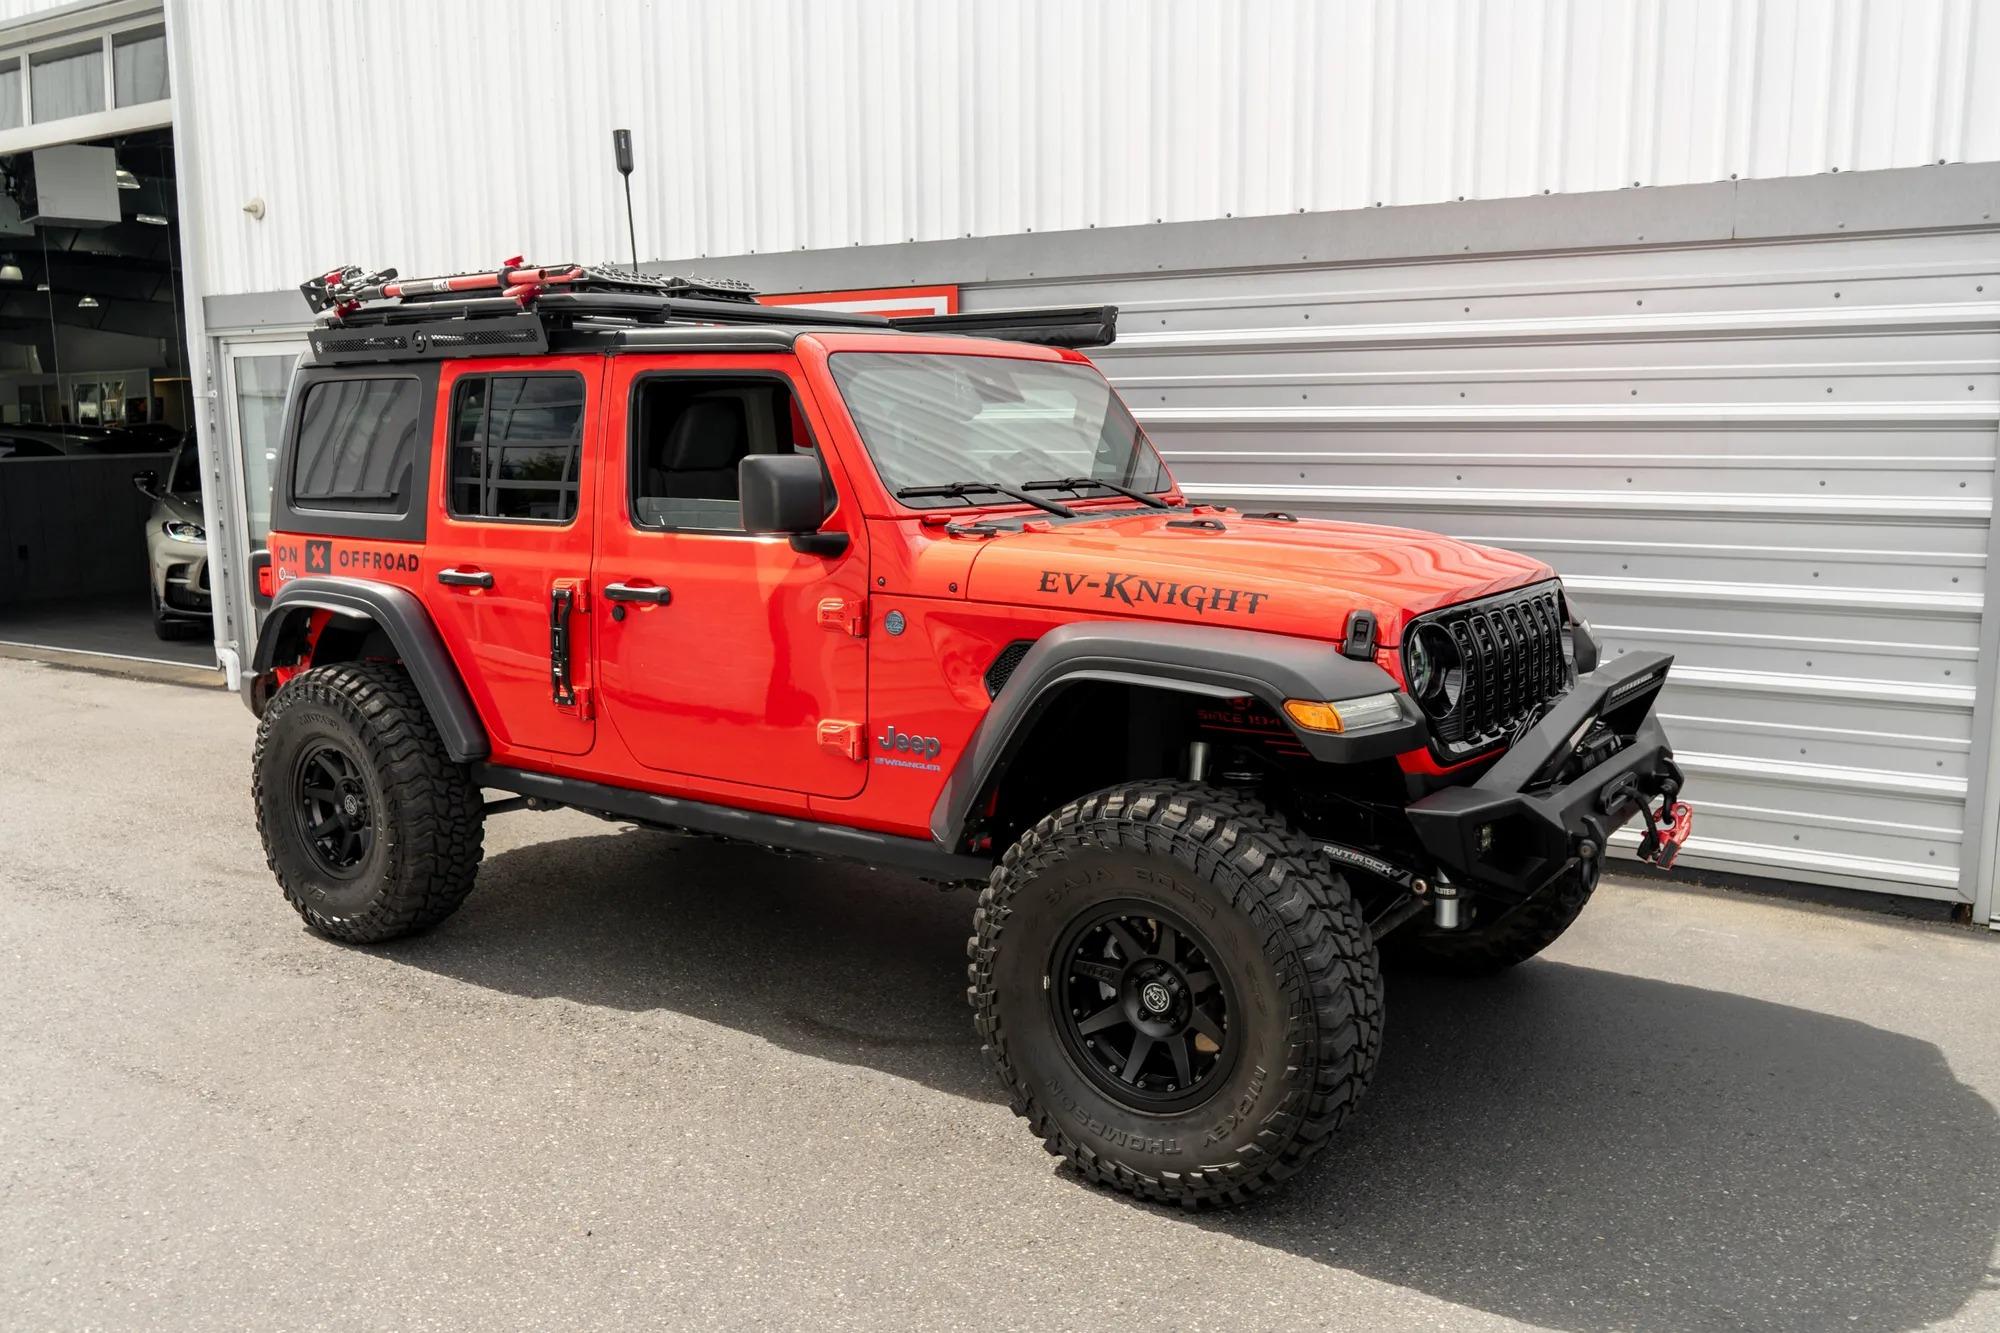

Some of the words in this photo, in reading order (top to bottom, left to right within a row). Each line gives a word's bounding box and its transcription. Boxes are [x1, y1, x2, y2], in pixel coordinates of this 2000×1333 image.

[278, 545, 298, 563] ON
[339, 550, 419, 572] OFFROAD
[877, 725, 941, 761] Jeep
[1323, 845, 1392, 875] ANTIROCK
[1044, 1078, 1183, 1155] THOMPSON
[1203, 1065, 1268, 1148] MICKEY
